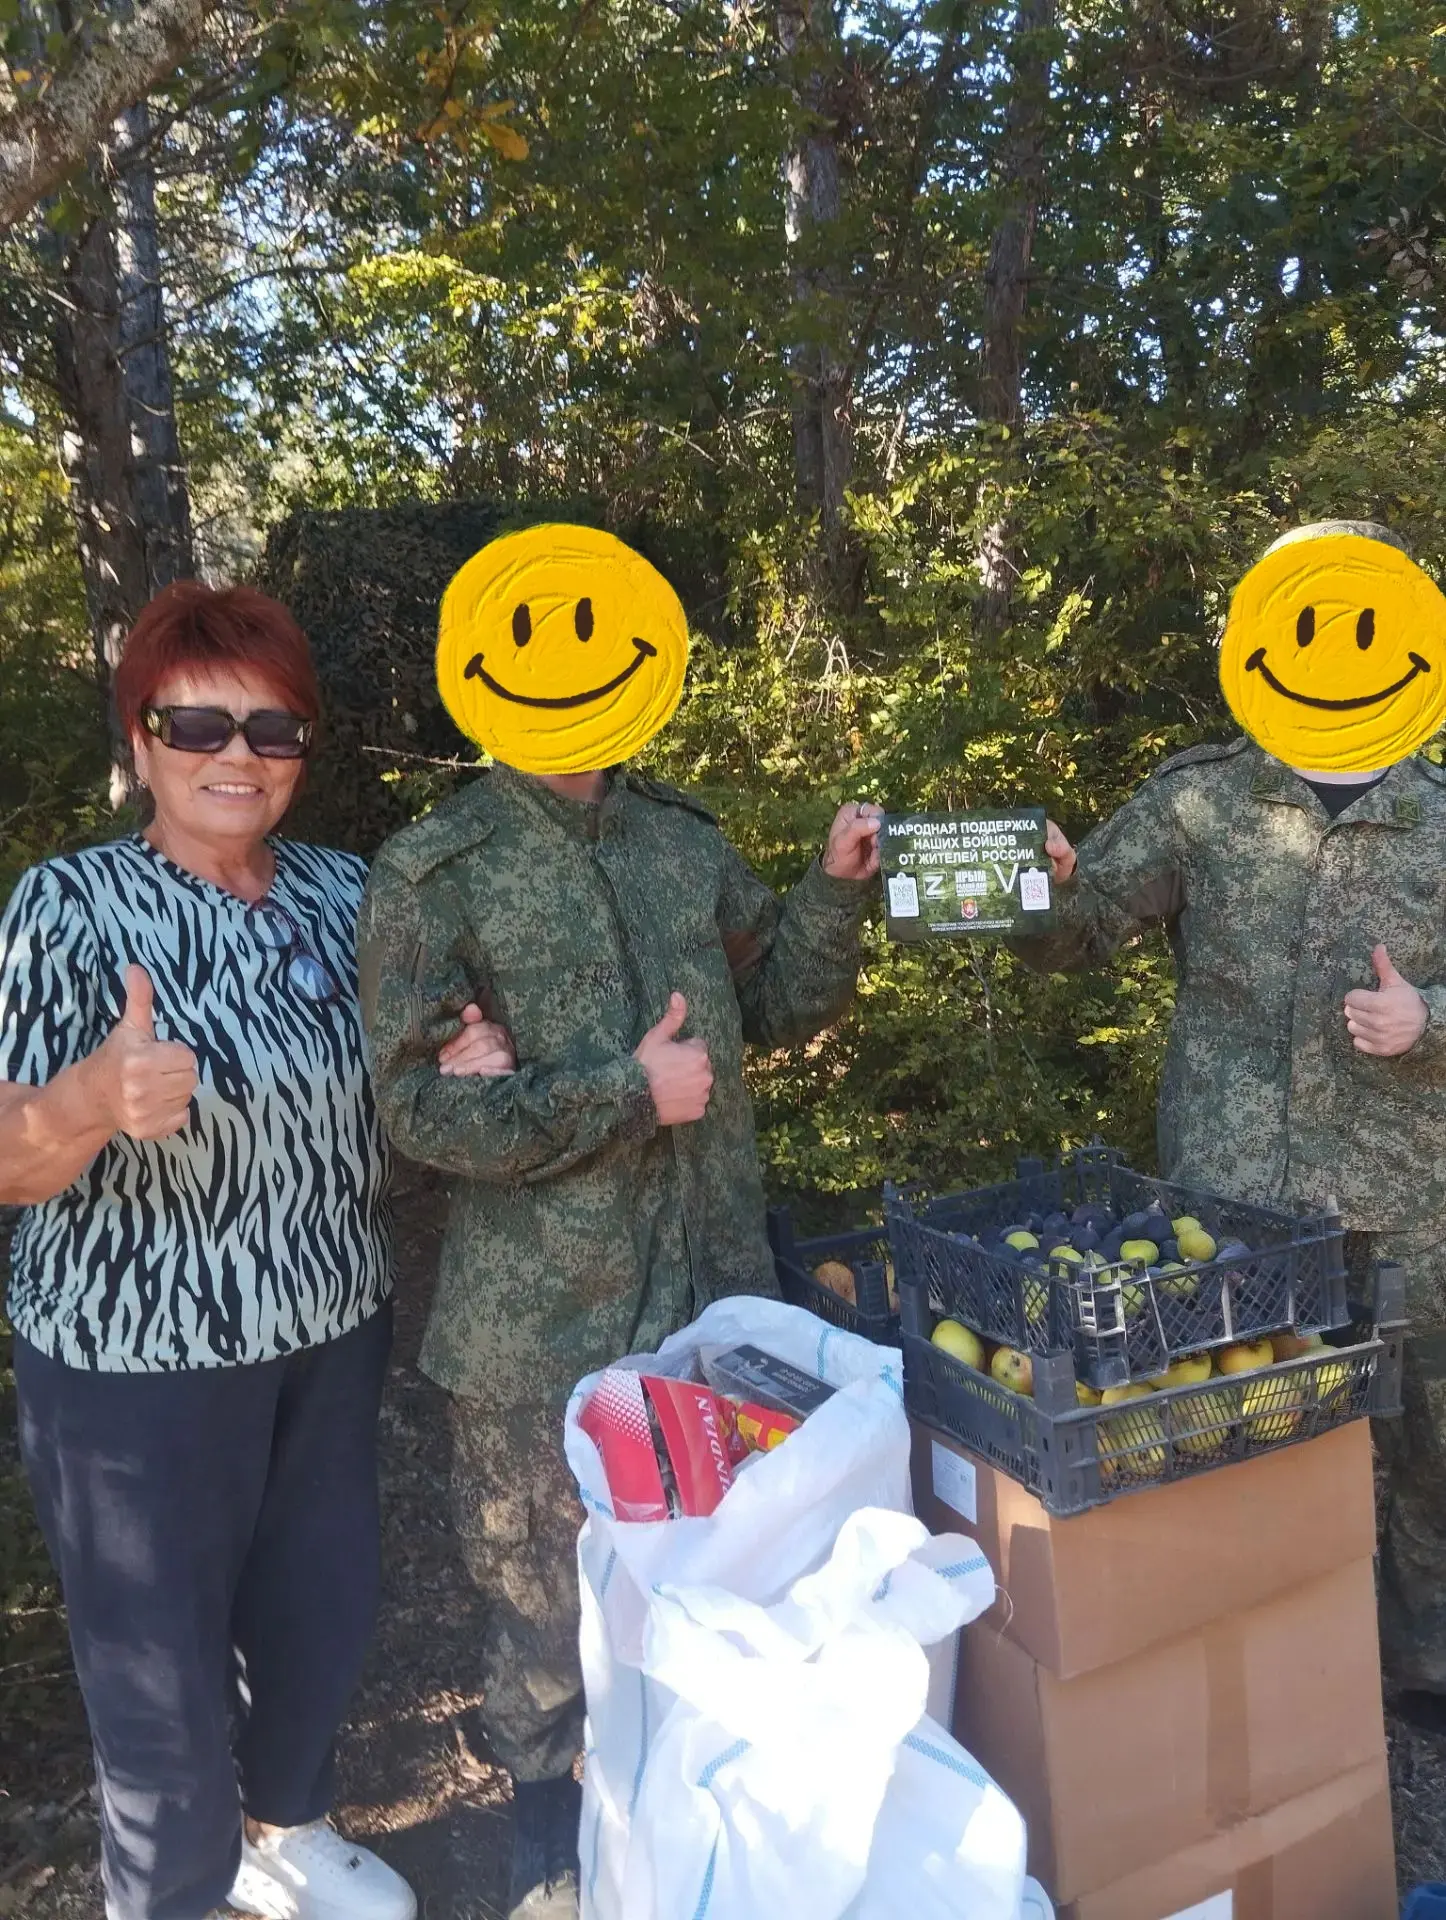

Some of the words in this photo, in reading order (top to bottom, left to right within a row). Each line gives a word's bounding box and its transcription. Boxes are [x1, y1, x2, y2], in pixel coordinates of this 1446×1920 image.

[888, 822, 957, 836] НАРОДНАЯ
[960, 819, 1038, 834] ПОДДЕРЖКА
[913, 837, 960, 850] НАШИХ
[963, 833, 1017, 849] БОЙЦОВ
[898, 853, 917, 866] ОТ
[919, 849, 979, 865] ЖИТЕЛЕЙ
[982, 848, 1035, 862] РОССИИ
[924, 876, 946, 896] Z
[993, 863, 1019, 893] V
